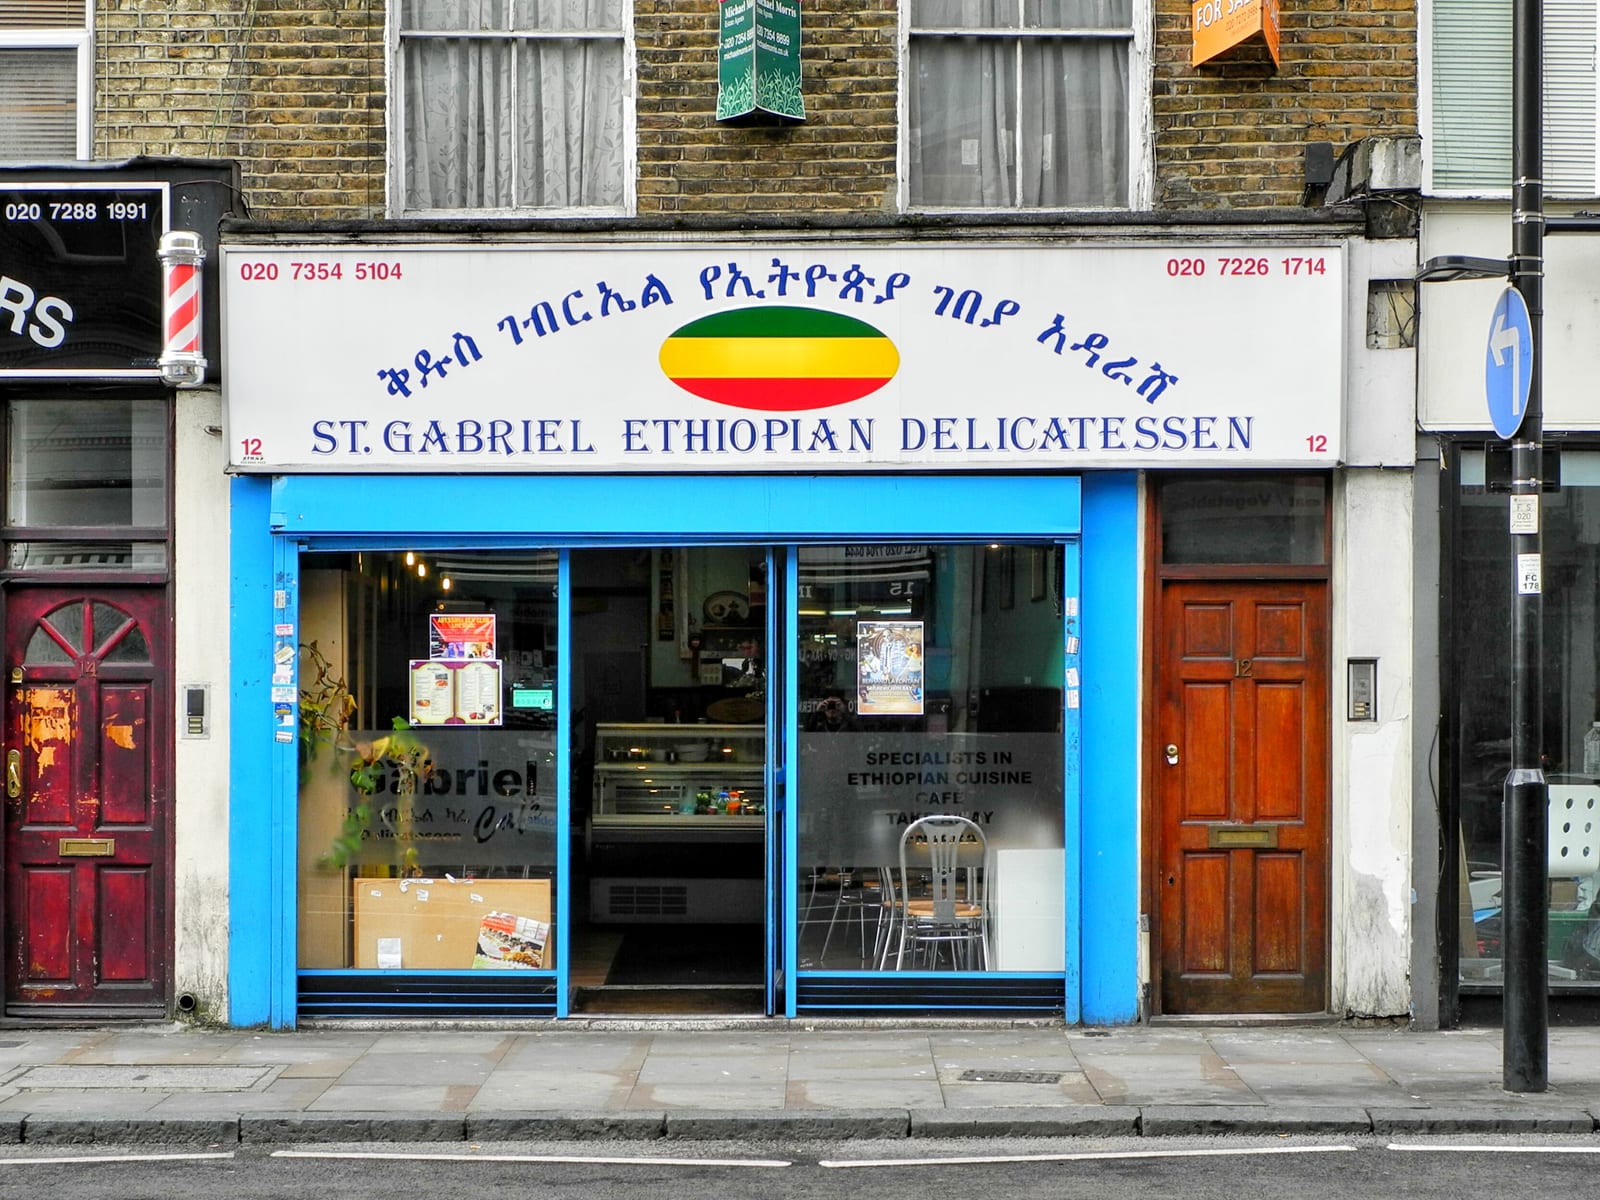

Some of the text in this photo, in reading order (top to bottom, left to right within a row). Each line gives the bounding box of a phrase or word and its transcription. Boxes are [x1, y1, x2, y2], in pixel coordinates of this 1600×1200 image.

[725, 1, 746, 19] Michael
[775, 1, 797, 18] Morris
[1196, 0, 1223, 32] FOR
[5, 203, 147, 221] 020 7288 1991
[240, 262, 403, 281] 020 7354 5104
[1166, 257, 1327, 277] 020 7226 1714
[0, 275, 74, 348] RS
[376, 332, 483, 397] ቅዱስ
[497, 273, 674, 345] ገብርኤል
[934, 285, 1020, 328] ገበያ
[383, 418, 595, 456] GABRIEL
[623, 418, 875, 454] ETHIOPIAN
[901, 416, 1254, 452] DELICATESSEN
[1306, 434, 1328, 453] 12
[240, 438, 263, 456] 12
[1522, 582, 1539, 590] 178
[1525, 574, 1537, 582] FC
[80, 660, 97, 679] 14
[1234, 659, 1253, 677] 12
[866, 751, 1013, 765] SPECIALISTS IN
[847, 770, 1033, 786] ETHIOPIAN CUISINE
[915, 791, 965, 805] CAFE
